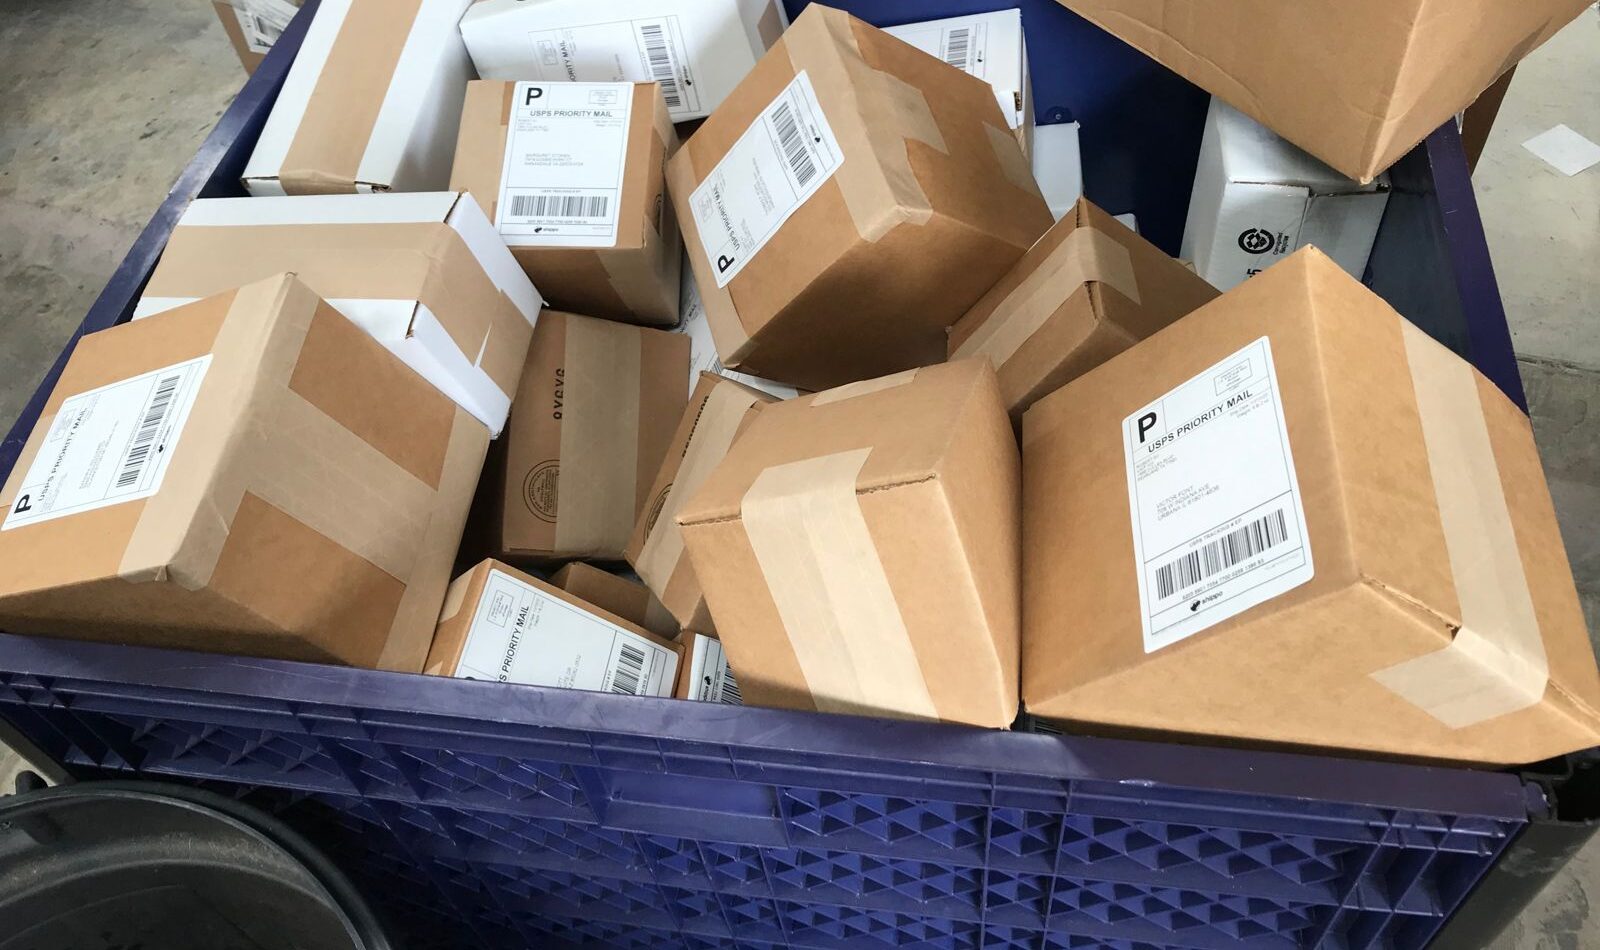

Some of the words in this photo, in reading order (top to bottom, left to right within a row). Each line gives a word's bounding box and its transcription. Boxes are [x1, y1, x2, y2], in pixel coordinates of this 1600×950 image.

[525, 87, 543, 105] P
[713, 183, 721, 200] MAIL
[718, 201, 732, 232] PRIORITY
[729, 231, 741, 251] USPS
[717, 254, 735, 274] P
[1137, 411, 1157, 443] P
[1148, 432, 1175, 453] USPS
[1177, 404, 1224, 437] PRIORITY
[1227, 389, 1253, 408] MAIL
[38, 475, 54, 501] USPS
[51, 432, 75, 474] PRIORITY
[73, 408, 88, 429] MAIL
[14, 494, 32, 514] P
[1201, 591, 1223, 604] shippo
[502, 628, 521, 673] PRIORITY
[516, 606, 529, 628] MAIL
